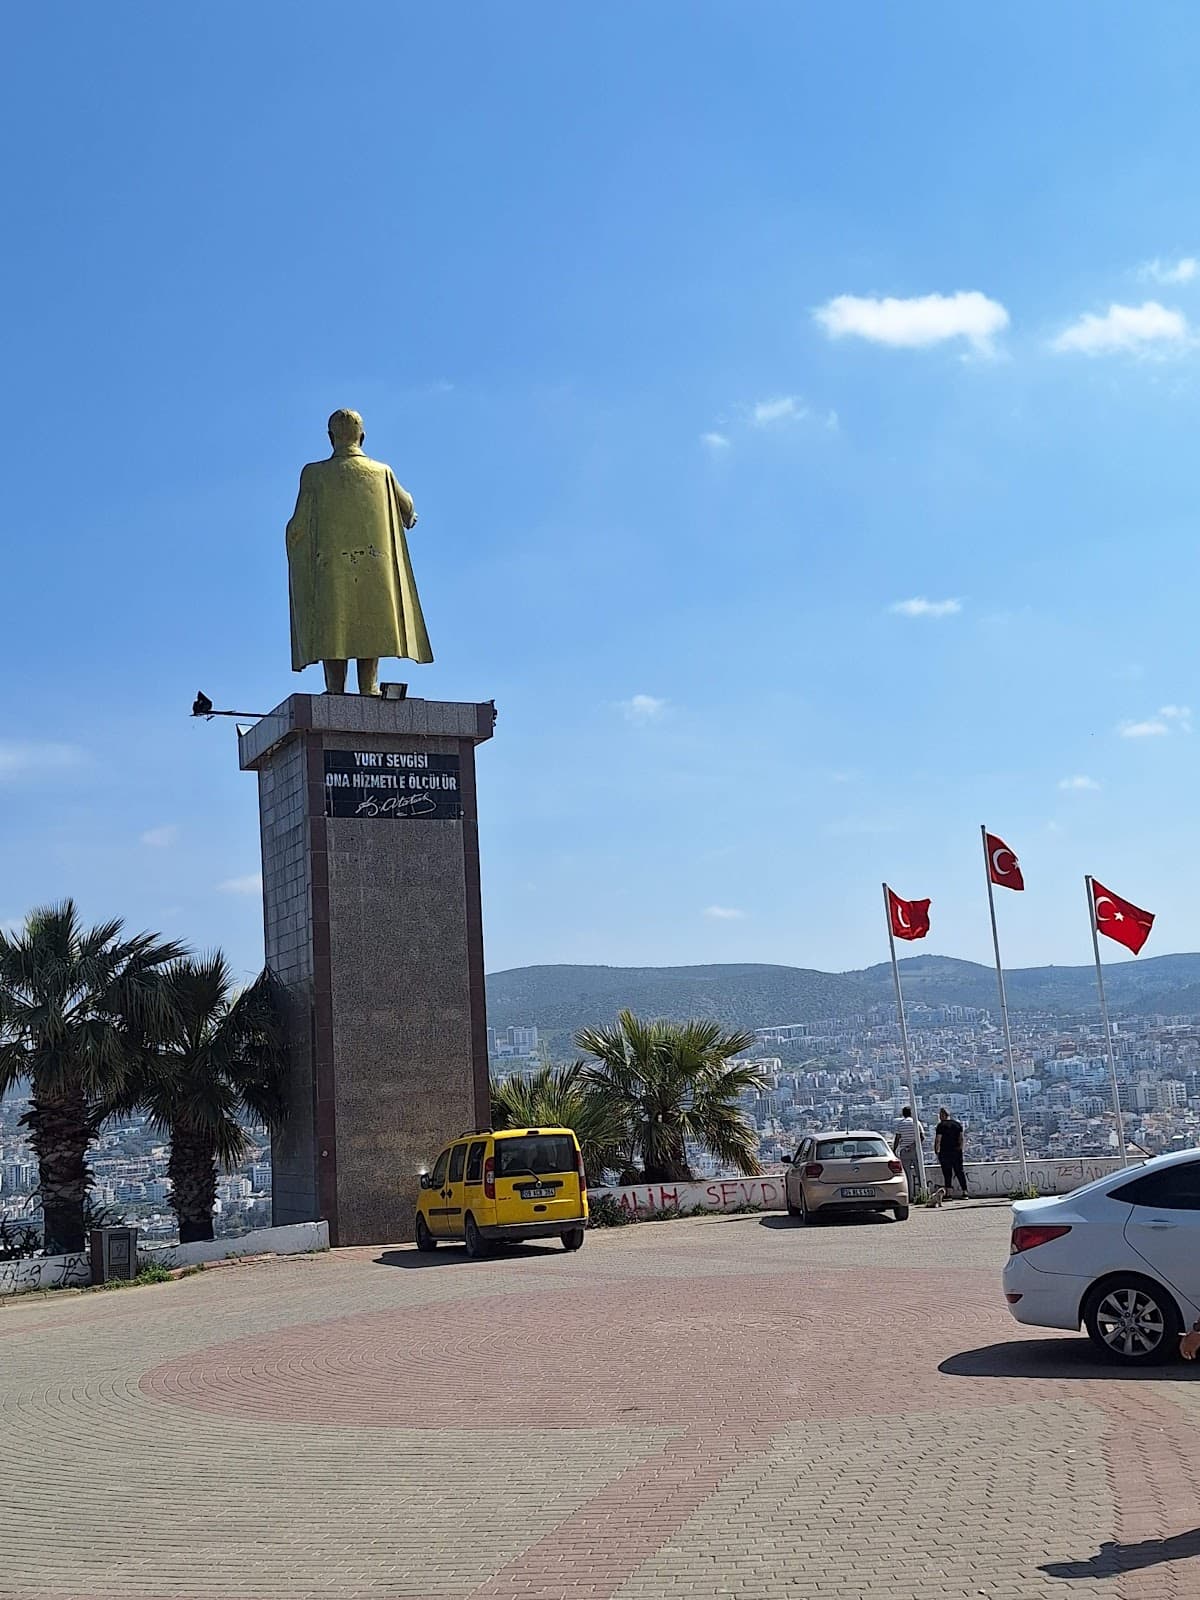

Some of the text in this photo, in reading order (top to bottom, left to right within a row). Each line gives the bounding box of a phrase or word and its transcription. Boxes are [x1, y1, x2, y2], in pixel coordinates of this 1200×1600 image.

[354, 752, 428, 768] YURT SEVGİSİ
[326, 773, 350, 787] ONA
[352, 771, 405, 789] HİZMETLE
